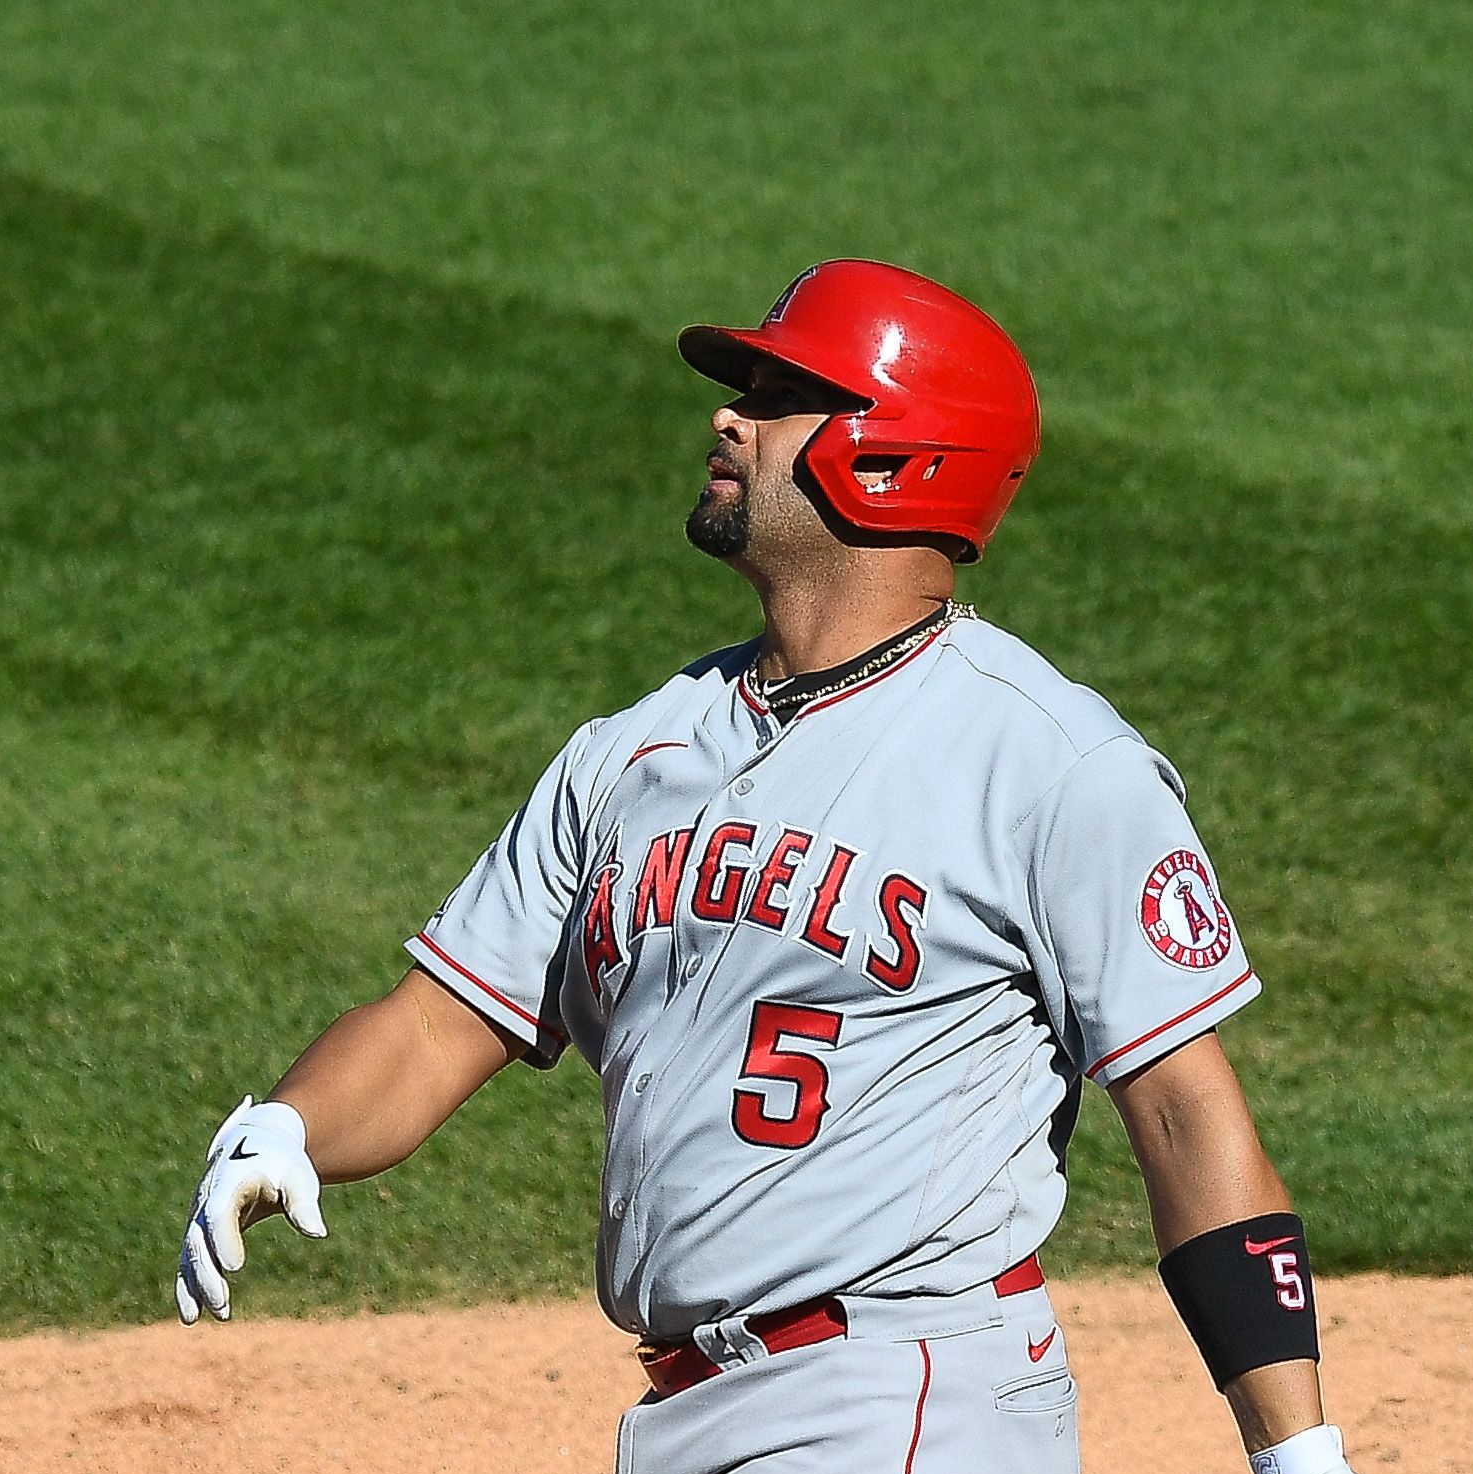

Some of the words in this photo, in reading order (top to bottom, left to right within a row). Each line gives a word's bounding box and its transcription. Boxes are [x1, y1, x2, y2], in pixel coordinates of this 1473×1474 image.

[583, 818, 929, 996] ANGELS
[732, 1000, 843, 1151] 5
[1267, 1252, 1307, 1312] 5
